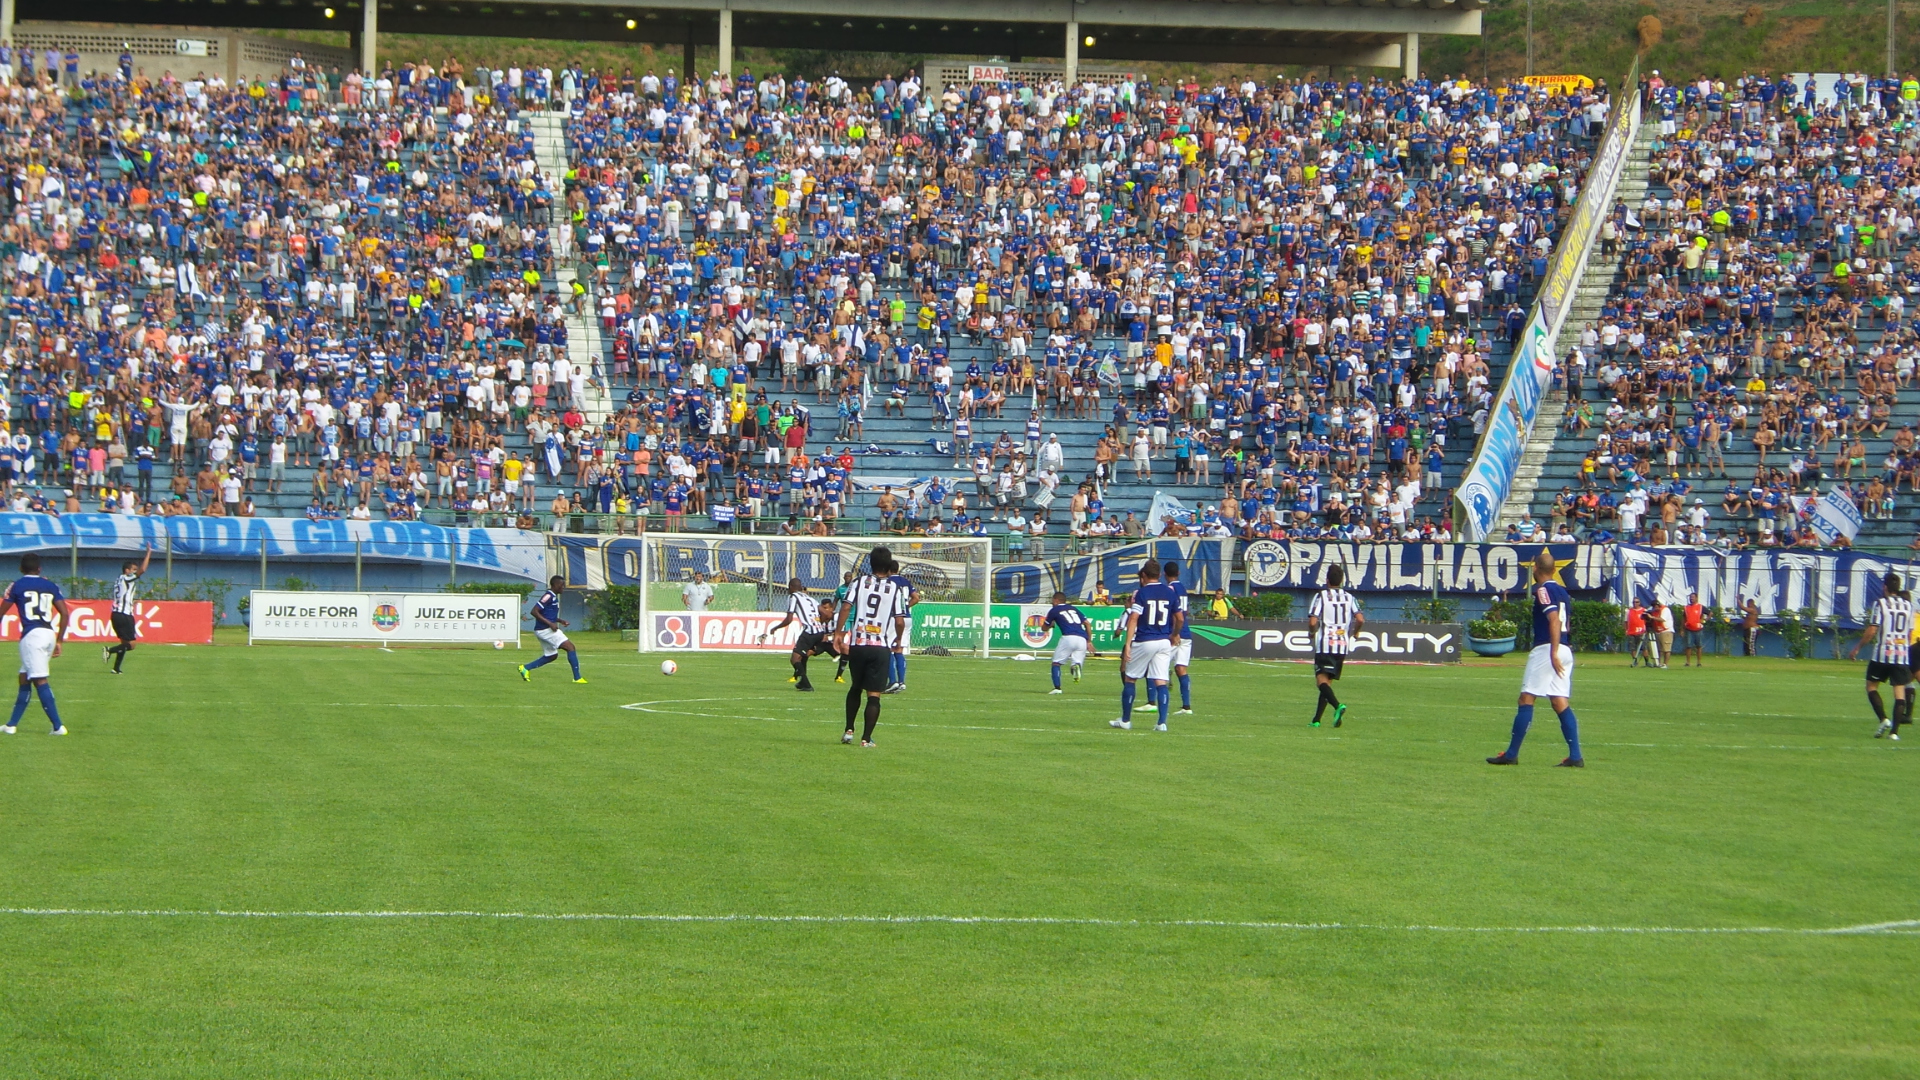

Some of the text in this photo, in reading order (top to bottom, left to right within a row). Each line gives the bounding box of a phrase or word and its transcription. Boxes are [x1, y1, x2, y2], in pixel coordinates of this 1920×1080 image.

[973, 67, 1003, 80] BAR
[132, 514, 284, 556] TODA
[292, 518, 501, 568] GLORIA
[990, 540, 1223, 604] OVEM
[24, 591, 54, 622] 29
[265, 606, 358, 618] JUIZ DE FORA
[414, 607, 506, 620] JUIZ DE FORA
[865, 593, 881, 618] 9
[1147, 600, 1169, 626] 15
[1332, 603, 1347, 624] 11
[265, 620, 358, 629] PREFEITURA
[414, 622, 506, 631] PREFEITURA
[921, 615, 1010, 629] JUIZ DE FORA
[1096, 620, 1112, 631] DE
[1889, 611, 1907, 633] 10
[921, 630, 1010, 640] PREFEITURA
[1255, 629, 1453, 654] PEALTY
